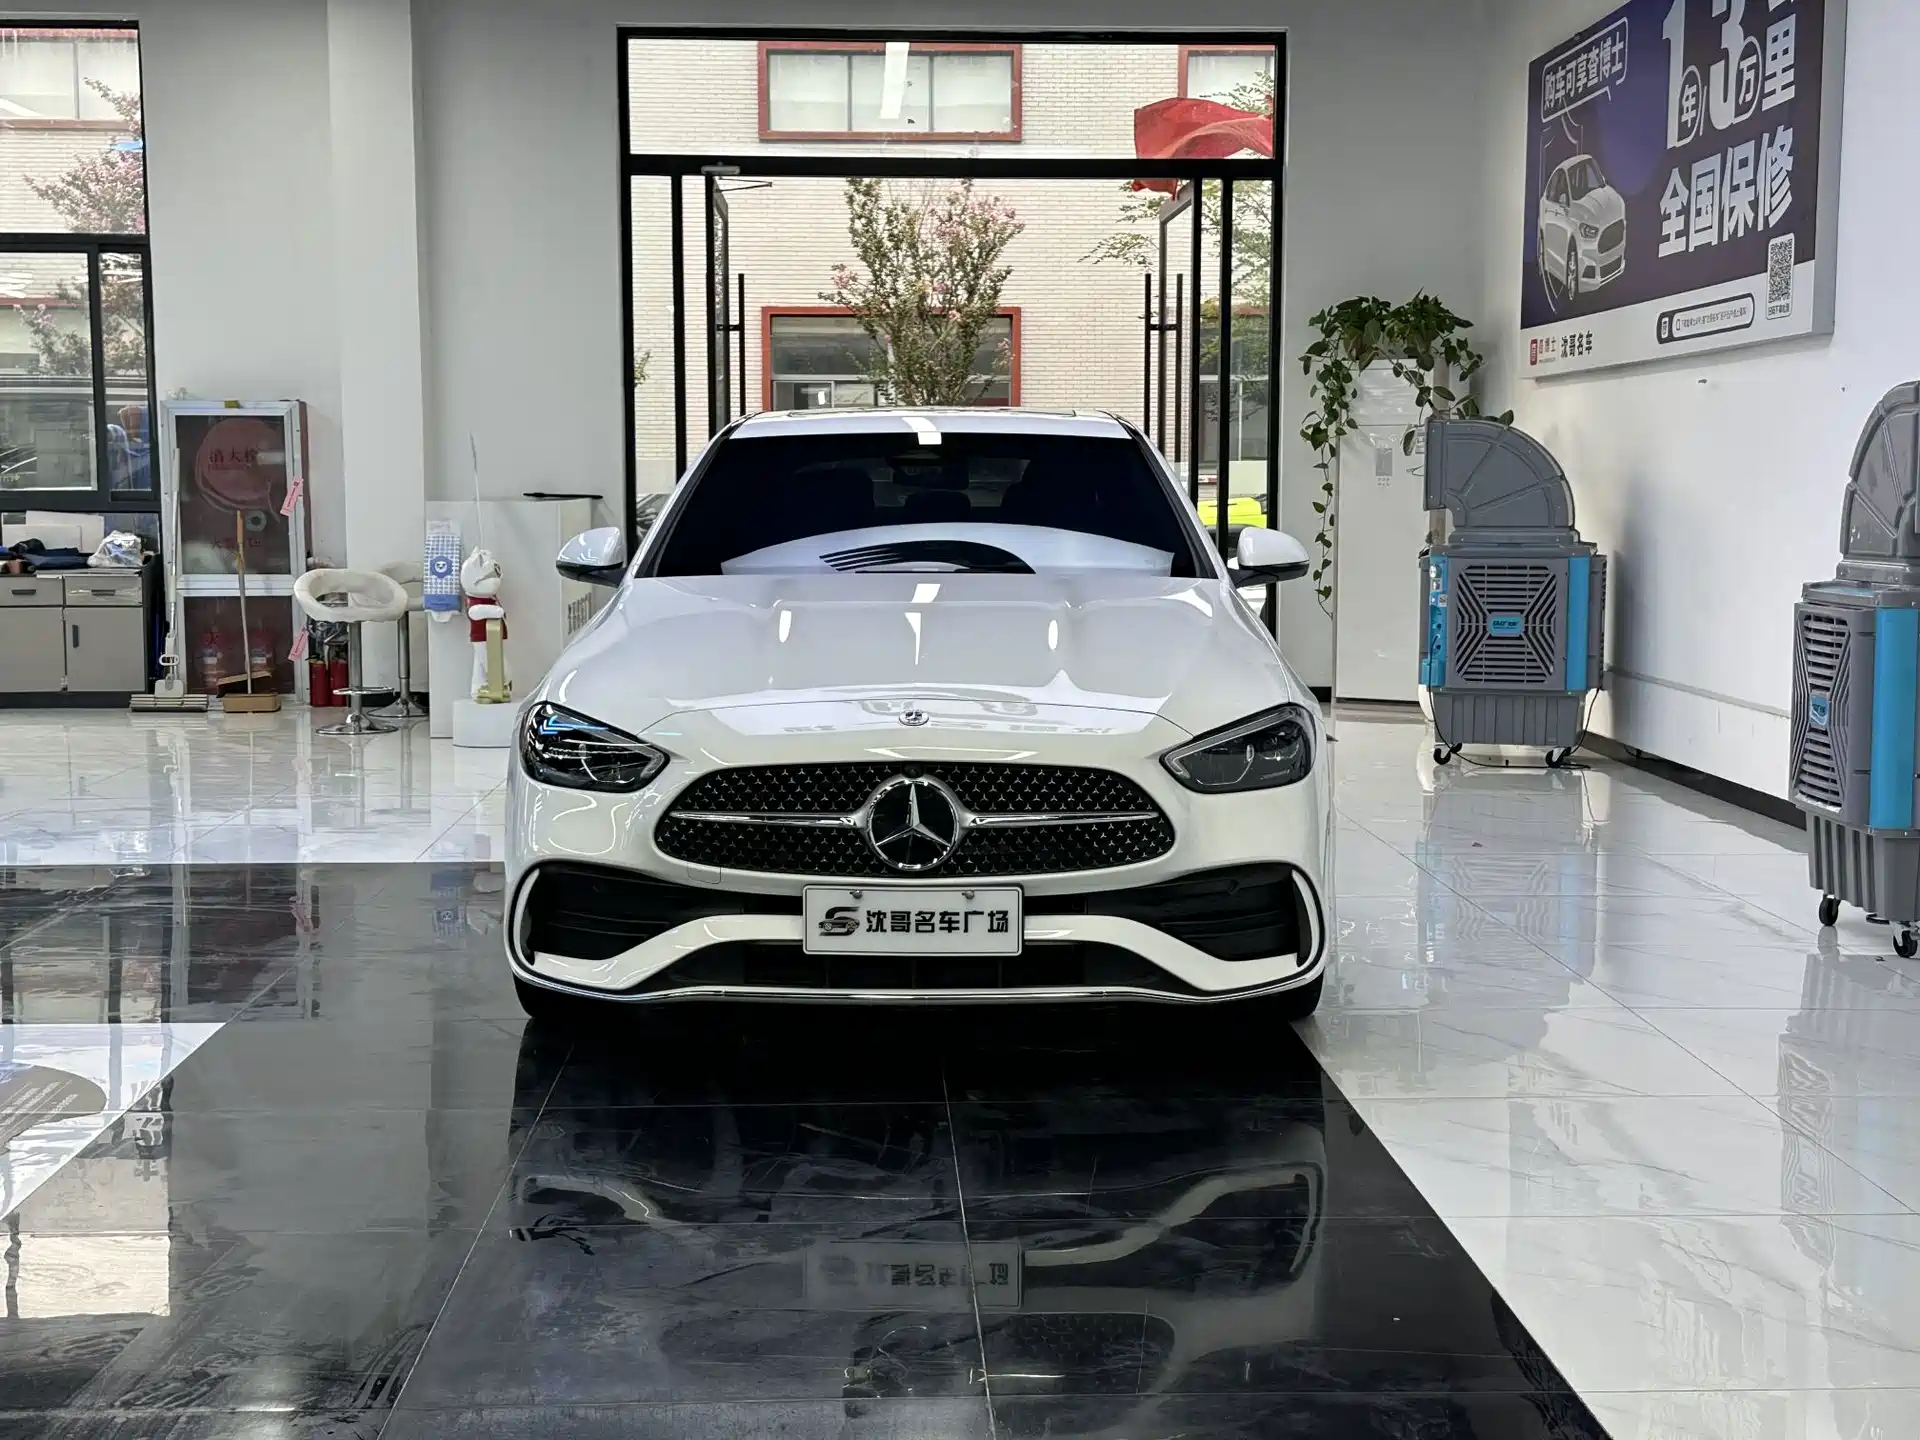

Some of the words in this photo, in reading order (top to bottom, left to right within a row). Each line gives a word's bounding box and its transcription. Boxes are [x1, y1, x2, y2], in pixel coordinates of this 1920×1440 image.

[1544, 31, 1624, 111] 购车可享查博士
[1658, 125, 1794, 258] 全国保修
[866, 910, 1009, 934] 沈哥名车广场
